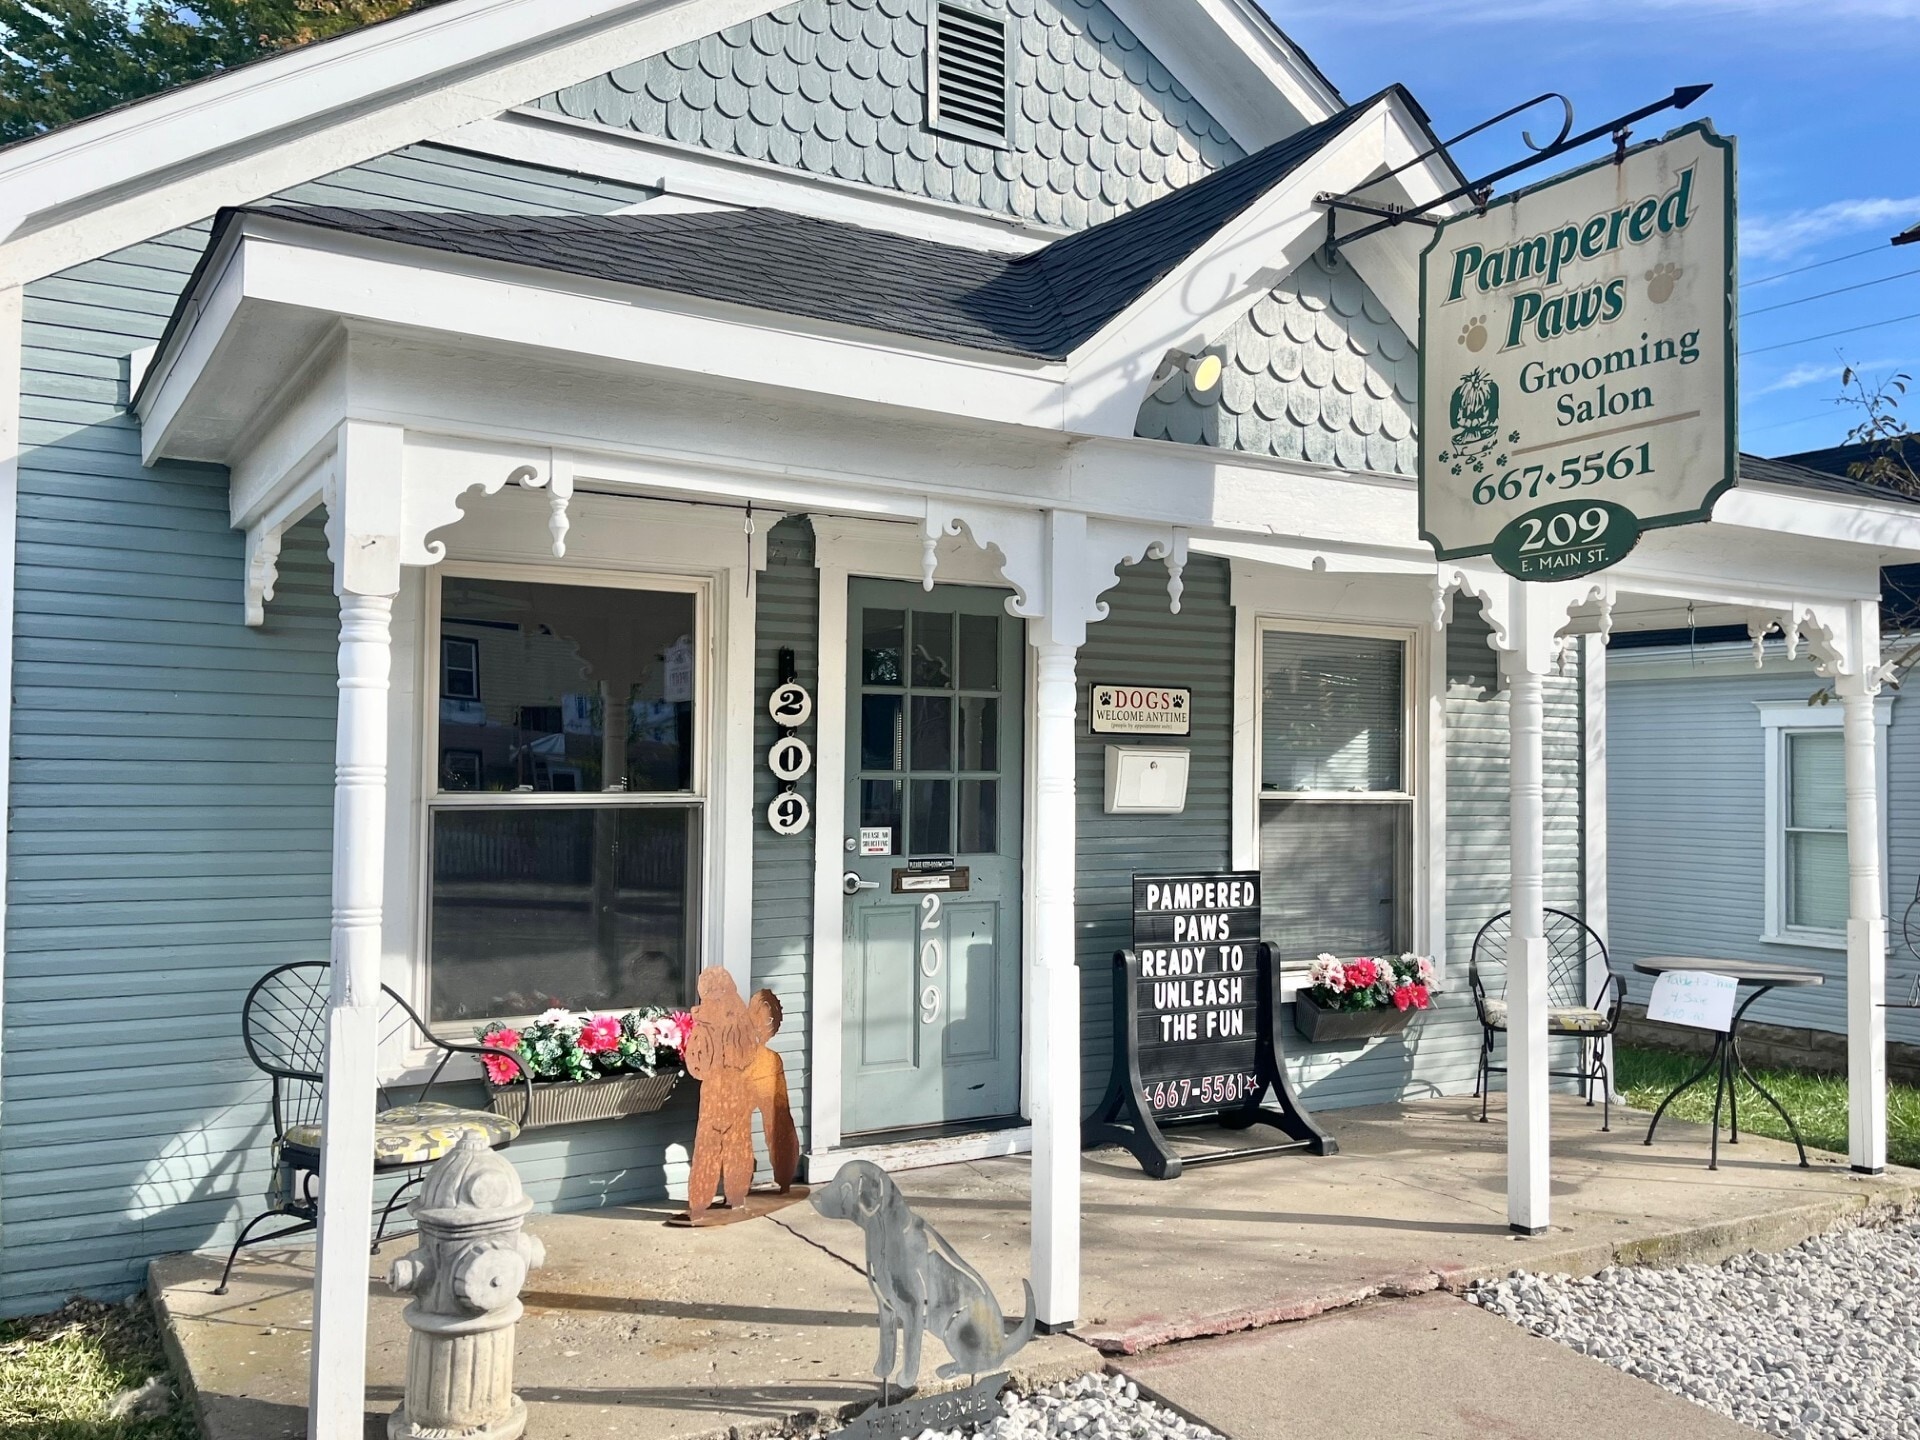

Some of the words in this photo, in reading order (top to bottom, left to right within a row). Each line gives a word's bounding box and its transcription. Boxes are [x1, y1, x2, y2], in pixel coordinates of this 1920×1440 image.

[1442, 159, 1698, 305] Pampered
[1500, 276, 1627, 352] Paws
[1519, 330, 1701, 395] Grooming
[1556, 385, 1655, 426] Salon
[1518, 507, 1610, 552] 209
[1521, 560, 1533, 572] E.
[1539, 552, 1581, 570] MAIN
[1587, 548, 1609, 564] ST.
[1096, 710, 1144, 721] WELCOME
[1146, 712, 1187, 722] ANYTIME
[1115, 690, 1170, 709] DOGS
[775, 690, 804, 827] 209
[1147, 881, 1255, 911] PAMPERED
[1174, 913, 1230, 943] PAWS
[920, 893, 942, 1024] 209
[1141, 946, 1206, 977] READY
[1219, 944, 1243, 972] TO
[1154, 977, 1242, 1010] UNLEASH
[1160, 1013, 1197, 1042] THE
[1206, 1009, 1243, 1038] FUN
[1153, 1073, 1243, 1110] 667-5561
[866, 1391, 988, 1438] WELCOME
